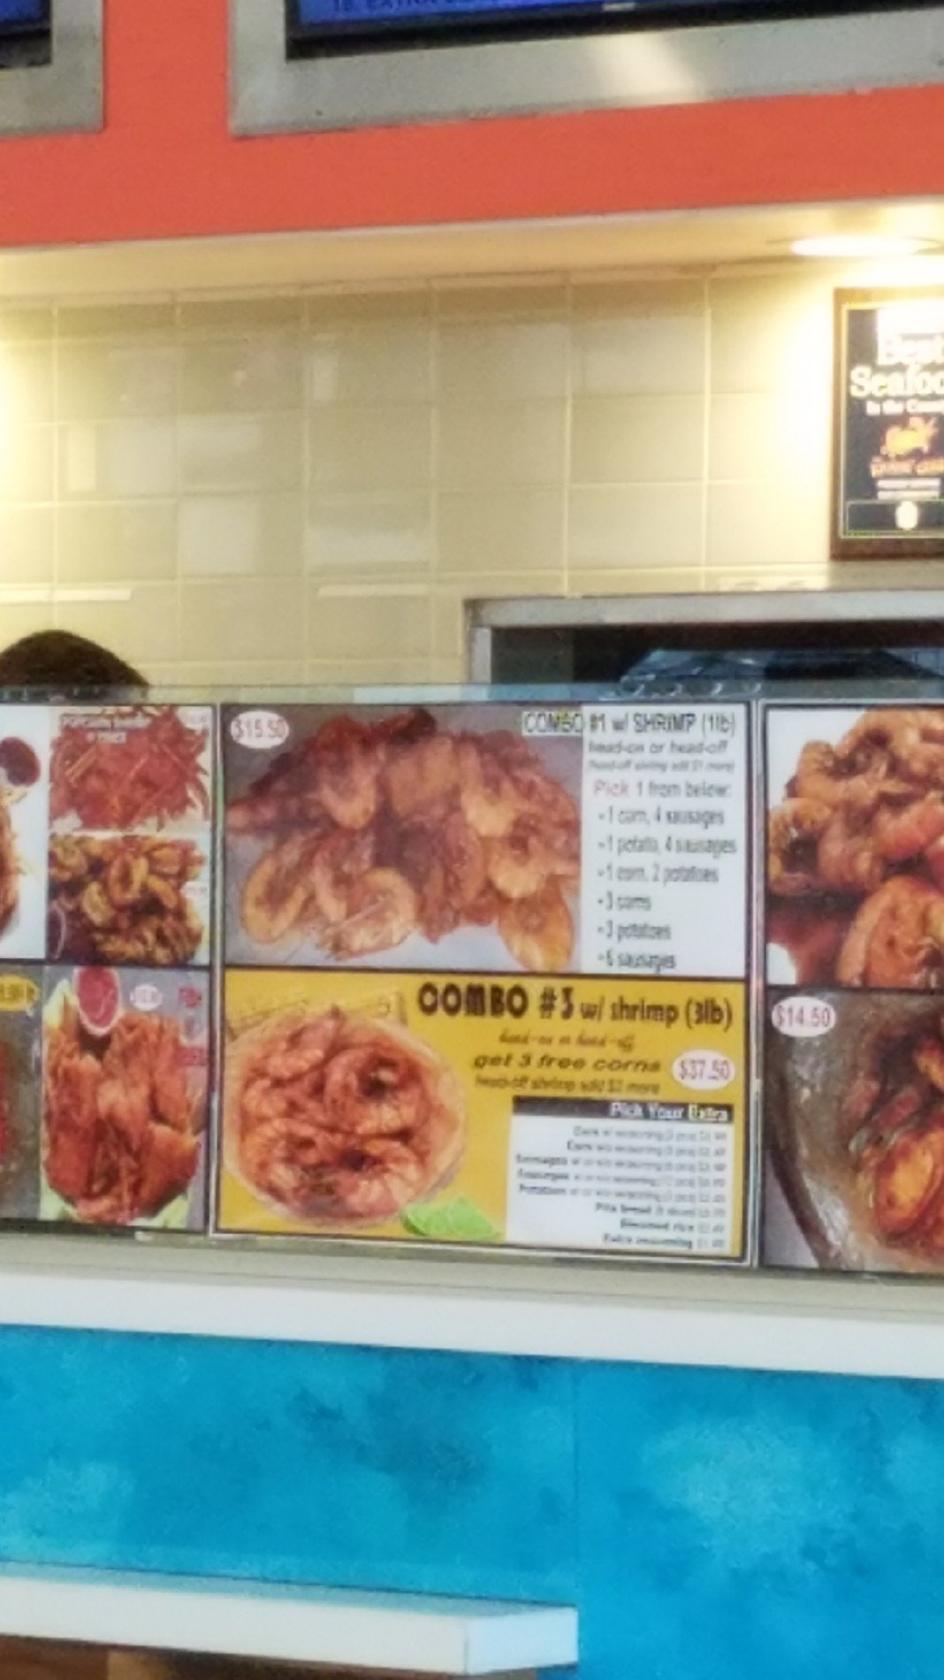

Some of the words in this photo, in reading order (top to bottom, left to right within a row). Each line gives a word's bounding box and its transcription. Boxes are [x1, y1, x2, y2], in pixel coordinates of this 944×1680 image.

[524, 713, 584, 734] COMBO
[590, 713, 606, 732] #1
[633, 713, 696, 733] SHRIMP
[593, 780, 629, 797] Pick
[648, 780, 680, 797] from
[418, 982, 529, 1018] COMBO
[540, 986, 574, 1020] #3
[610, 997, 679, 1027] shrimp
[473, 1053, 513, 1069] get
[518, 1053, 532, 1067] 3
[537, 1054, 587, 1070] free
[592, 1059, 661, 1073] corns
[678, 1058, 731, 1082] $37.50
[610, 1101, 643, 1117] Pick
